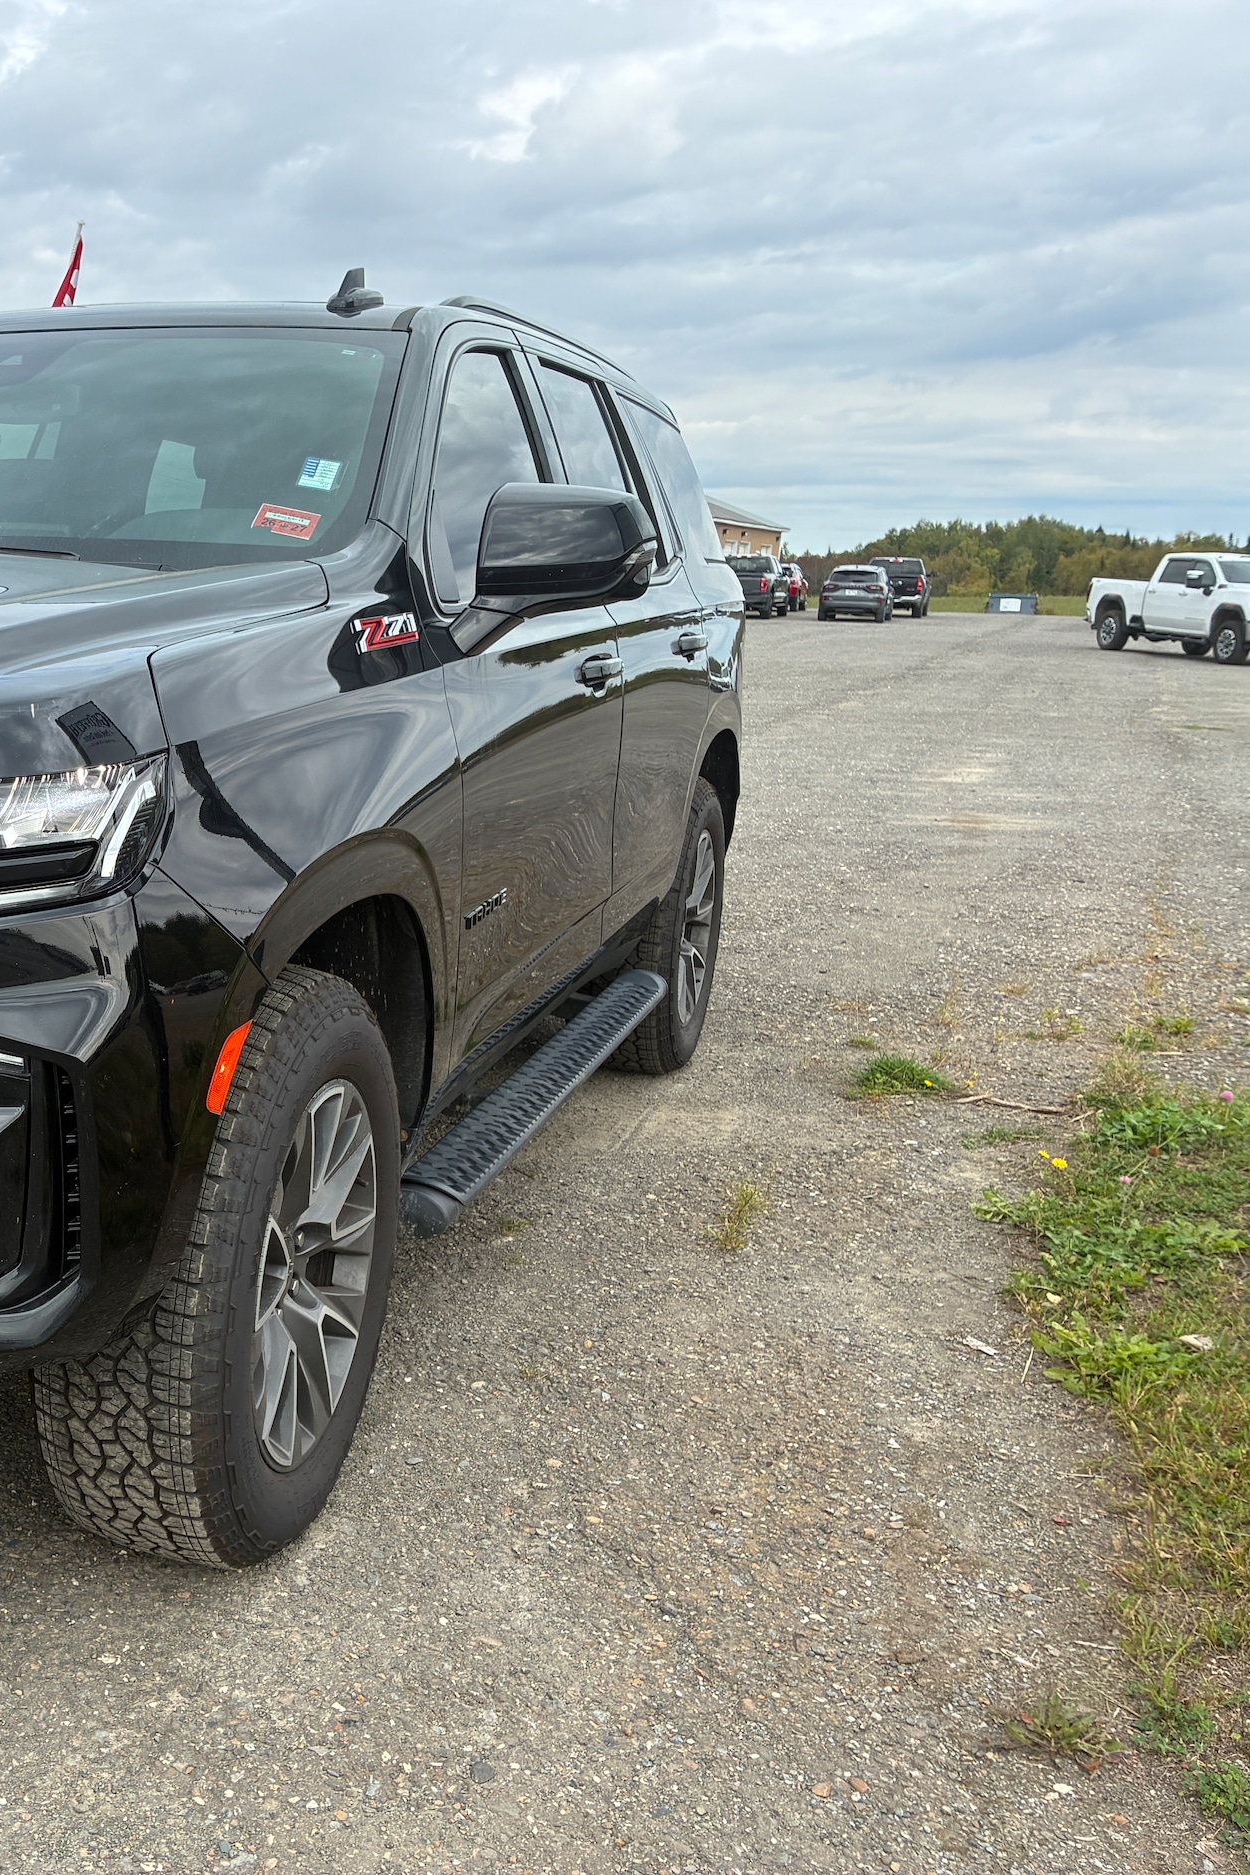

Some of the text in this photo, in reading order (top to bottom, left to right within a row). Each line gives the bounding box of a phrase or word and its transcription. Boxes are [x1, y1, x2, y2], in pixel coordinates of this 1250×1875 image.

[261, 518, 276, 527] 26
[290, 524, 308, 533] 27
[351, 612, 419, 655] Z71
[463, 887, 508, 931] TAHOE
